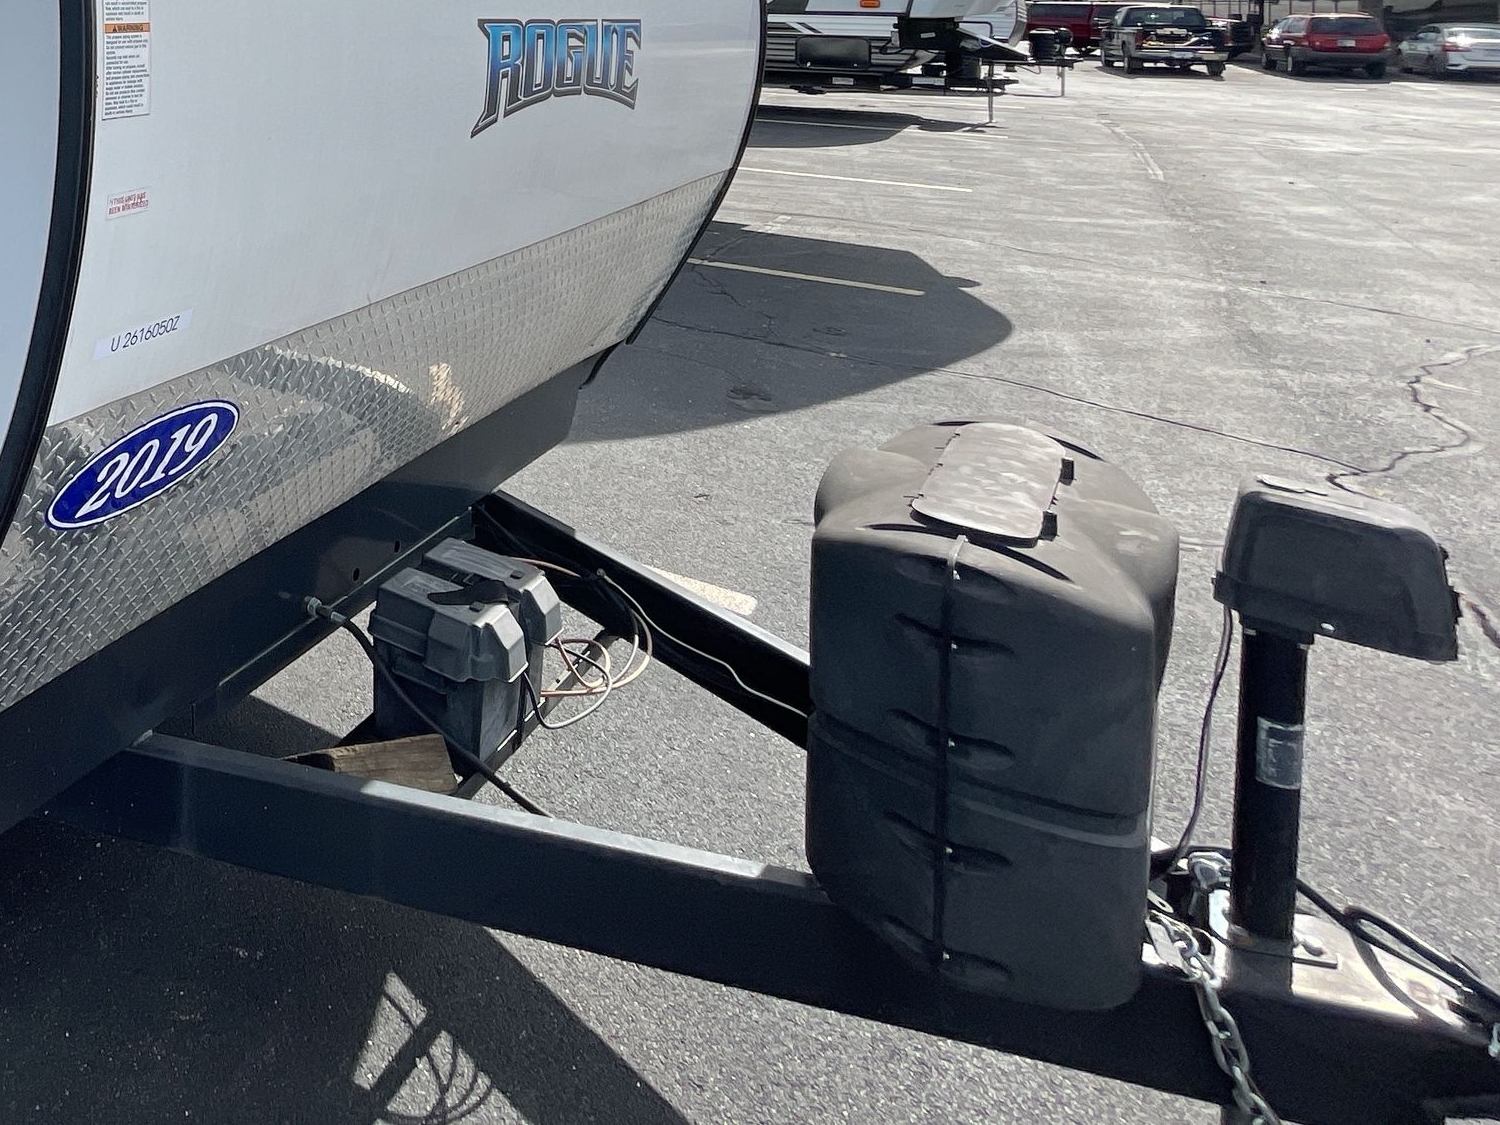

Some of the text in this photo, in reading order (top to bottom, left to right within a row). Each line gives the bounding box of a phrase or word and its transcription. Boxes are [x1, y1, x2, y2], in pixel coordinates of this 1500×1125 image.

[118, 24, 143, 32] WARNING
[470, 19, 641, 138] ROGUE
[110, 335, 121, 352] U
[75, 413, 218, 518] 2019
